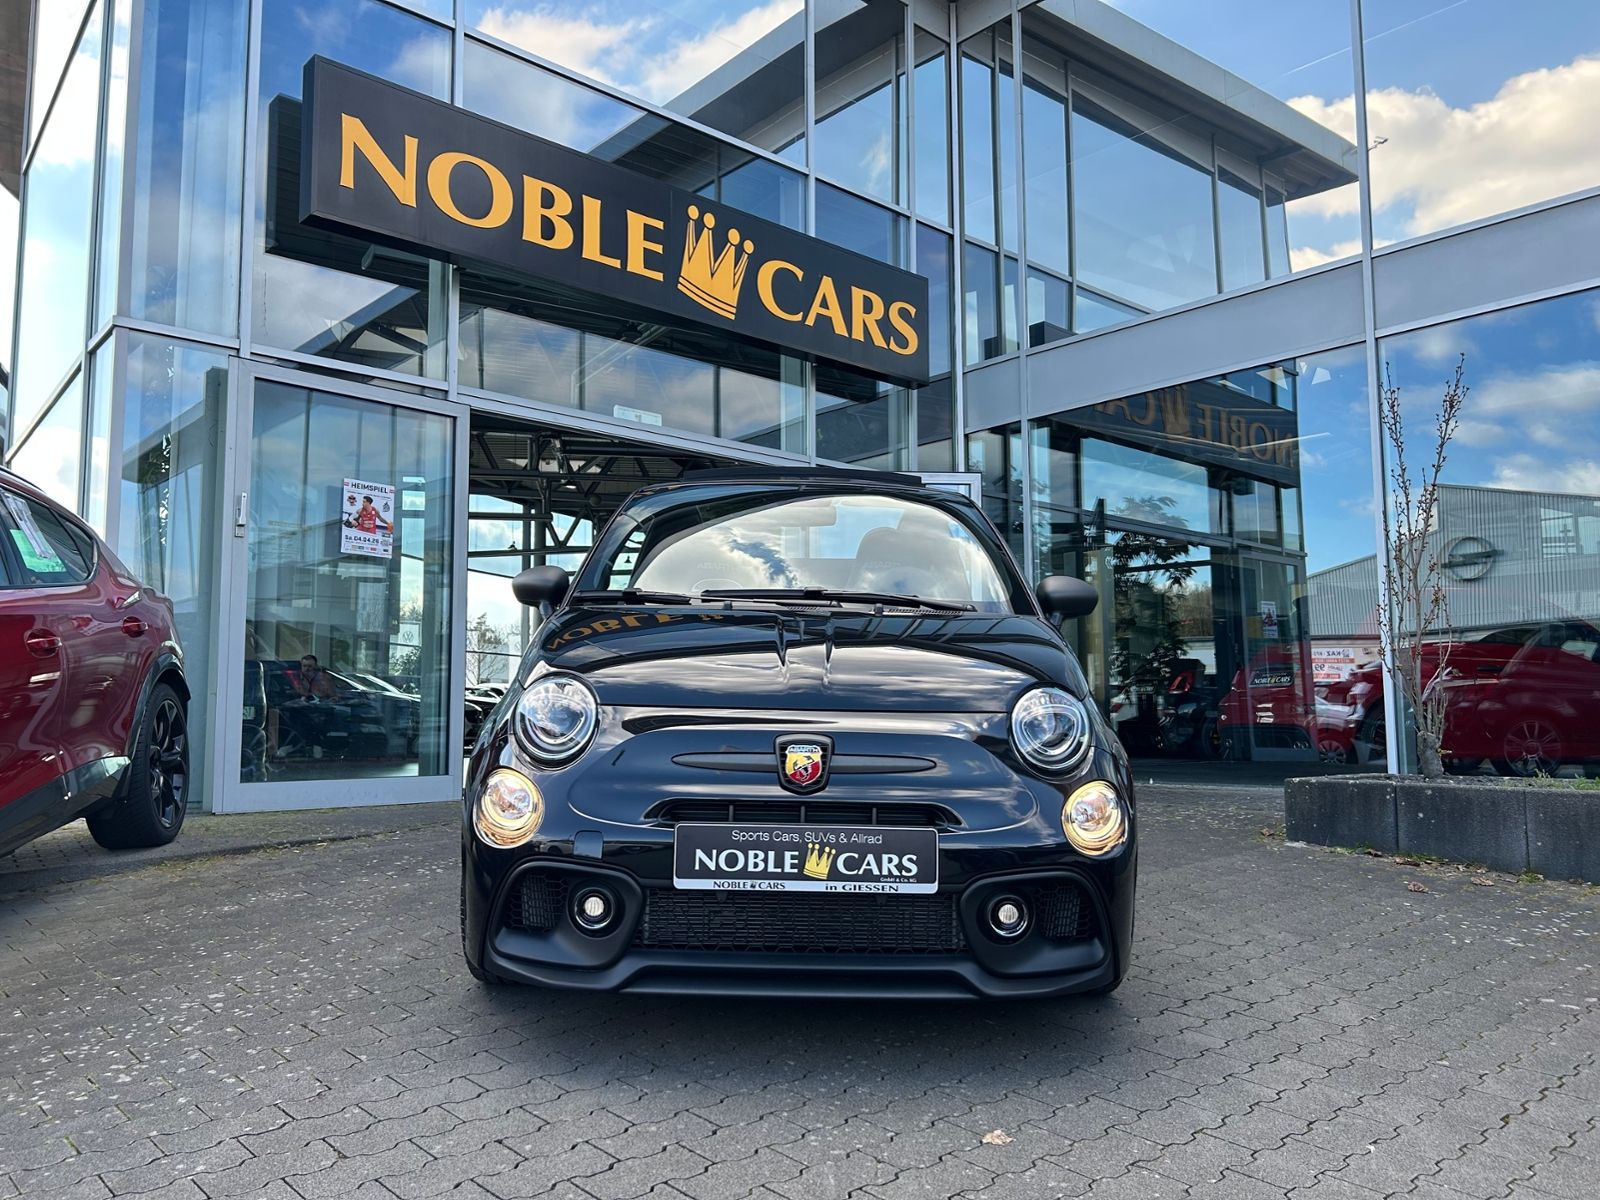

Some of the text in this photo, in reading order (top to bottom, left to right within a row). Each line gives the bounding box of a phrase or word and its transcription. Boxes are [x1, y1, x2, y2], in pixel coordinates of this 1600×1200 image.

[340, 114, 918, 355] NOBLE CARS
[351, 482, 388, 494] HEIMSPIEL
[731, 830, 882, 844] Sports Cars, SUVs & Allrad
[694, 848, 918, 876] NOBLE CARS
[713, 881, 748, 889] NOBLE
[825, 883, 899, 892] in GIESSEN
